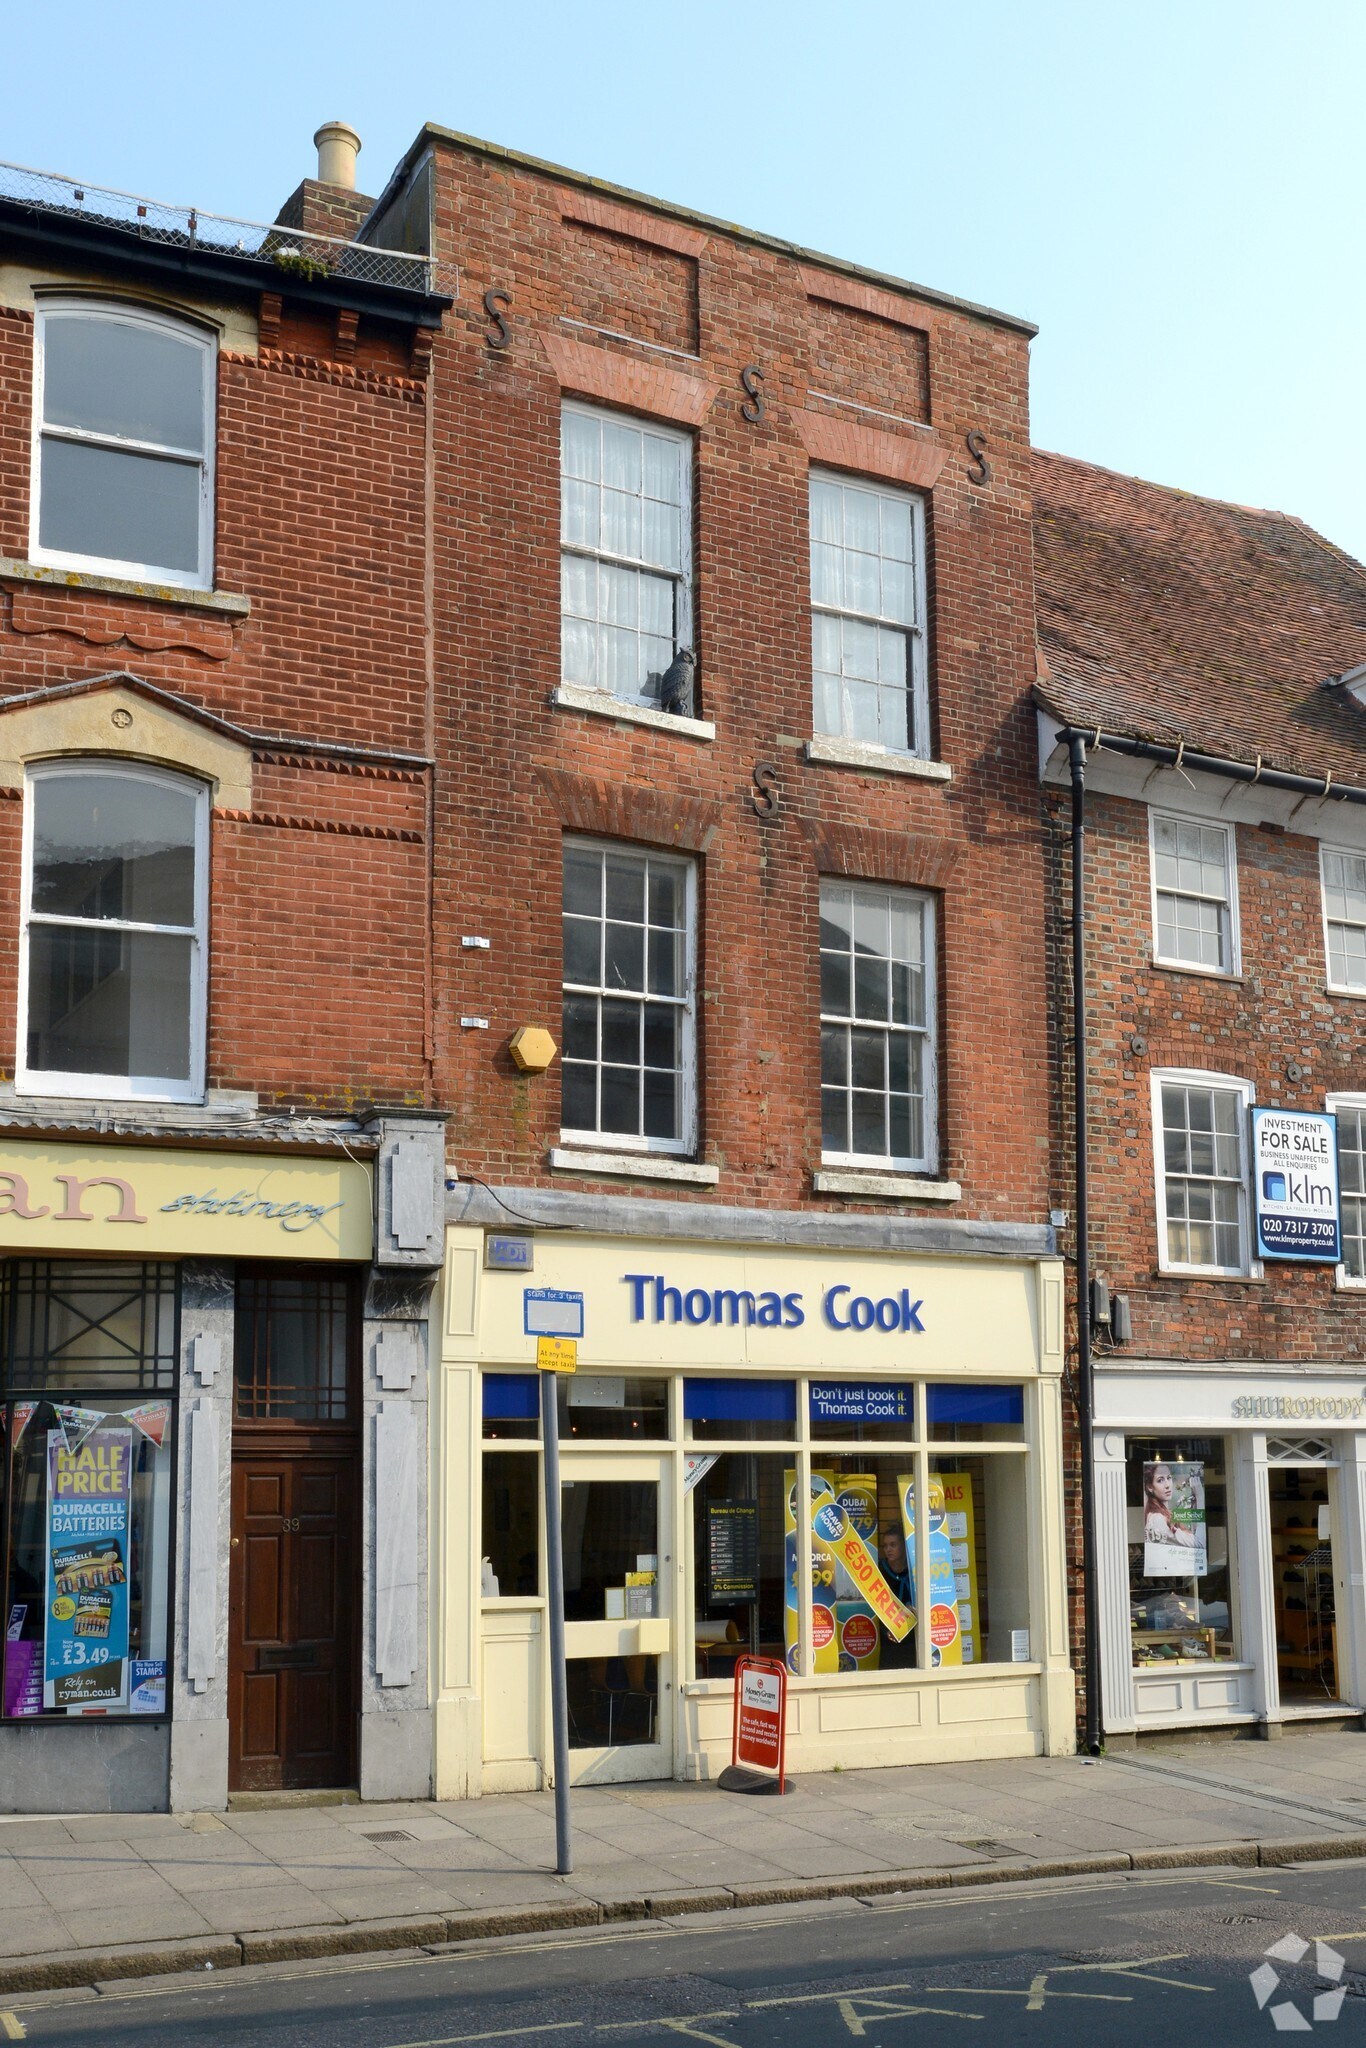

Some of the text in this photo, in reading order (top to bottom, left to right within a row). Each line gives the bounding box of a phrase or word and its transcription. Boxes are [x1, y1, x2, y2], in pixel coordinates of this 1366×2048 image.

[1264, 1117, 1323, 1134] INVESTMENT
[1261, 1131, 1328, 1154] FOR SALE
[1260, 1150, 1329, 1164] BUSINESS UNAFFECTED
[1273, 1159, 1318, 1171] ALL ENQUIRIES
[1288, 1173, 1333, 1206] klm
[159, 1187, 345, 1232] stationery
[1263, 1218, 1335, 1237] 020 7317 3700
[1264, 1234, 1335, 1248] www.klmproperty.co.uk
[527, 1289, 583, 1301] Stand for 3 taxis
[624, 1274, 927, 1332] Thomas Cook
[550, 1351, 560, 1359] any
[561, 1352, 575, 1360] time
[538, 1360, 575, 1369] except taxis
[812, 1387, 907, 1403] Don't just book it.
[818, 1401, 907, 1416] Thomas Cook it.
[1236, 1395, 1364, 1418] SHUROPODY
[57, 1446, 124, 1471] HALF
[52, 1503, 125, 1516] DURACELL
[842, 1498, 868, 1507] DUBAI
[736, 1507, 755, 1515] Change
[1173, 1511, 1203, 1520] Josef Seibel
[52, 1515, 126, 1532] BATTERIES
[282, 1518, 300, 1532] 39
[819, 1512, 840, 1538] MONEY
[825, 1507, 845, 1534] TRAVEL
[54, 1552, 89, 1565] DURACELL
[844, 1540, 911, 1629] €50 FREE
[79, 1595, 111, 1604] DURACELL
[53, 1603, 61, 1616] 8
[930, 1610, 938, 1625] 3
[848, 1621, 858, 1636] 3
[63, 1642, 109, 1665] £3.49
[136, 1667, 163, 1676] STAMPS
[64, 1676, 83, 1691] Rely
[59, 1687, 117, 1699] ryman.co.uk
[745, 1686, 776, 1700] MoneyGram
[746, 1725, 756, 1734] send
[756, 1728, 764, 1736] and
[764, 1730, 778, 1739] receive
[760, 1720, 768, 1728] fast
[768, 1722, 777, 1732] way
[741, 1734, 777, 1747] money worldwide
